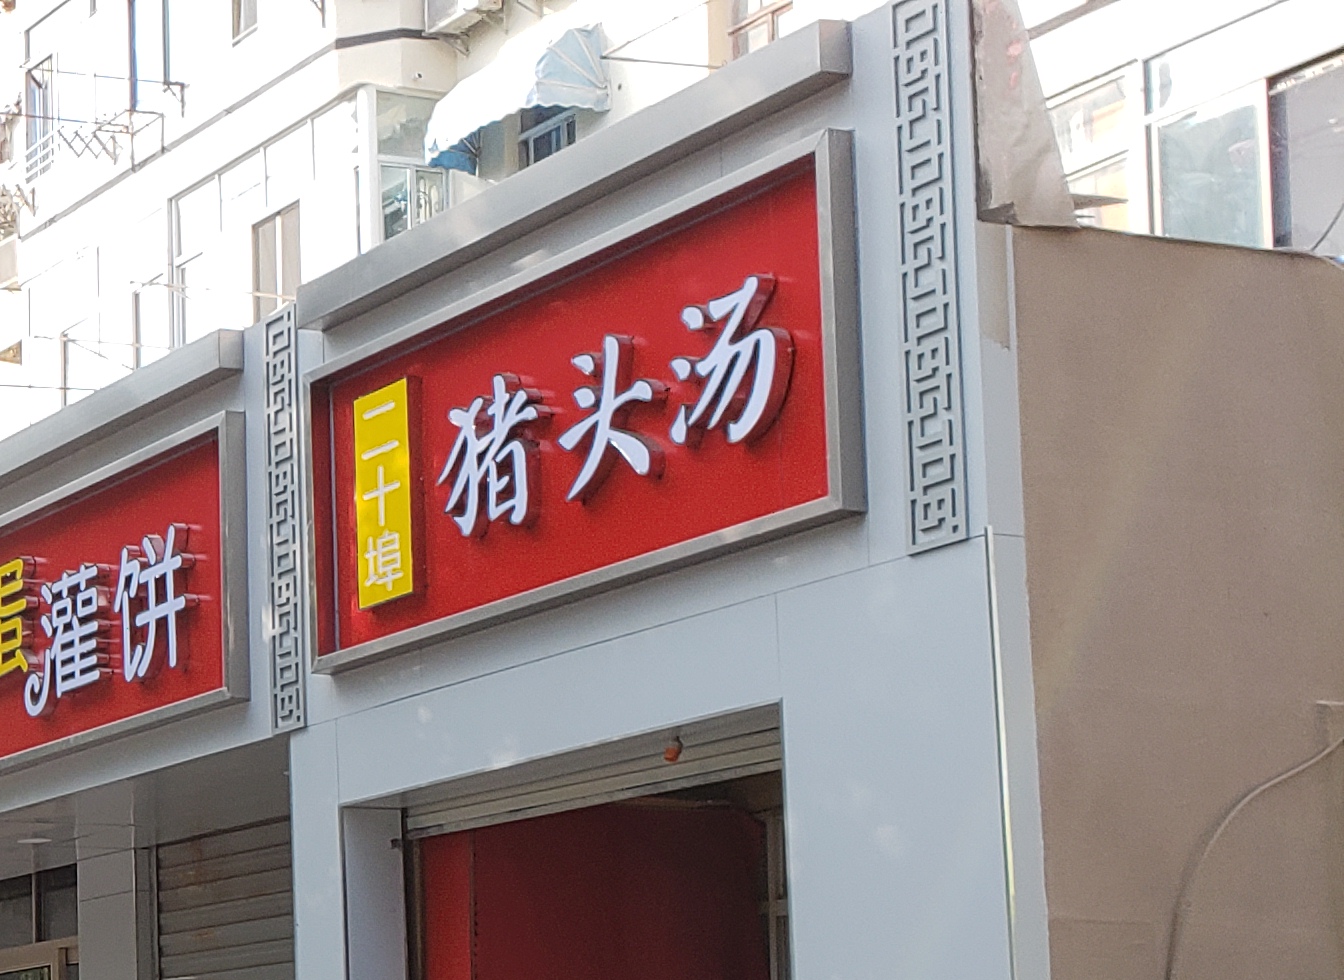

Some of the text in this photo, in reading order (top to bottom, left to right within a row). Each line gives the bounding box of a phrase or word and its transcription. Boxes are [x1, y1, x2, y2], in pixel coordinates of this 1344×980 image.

[361, 399, 404, 592] 二十埠
[436, 275, 777, 538] 猪头汤
